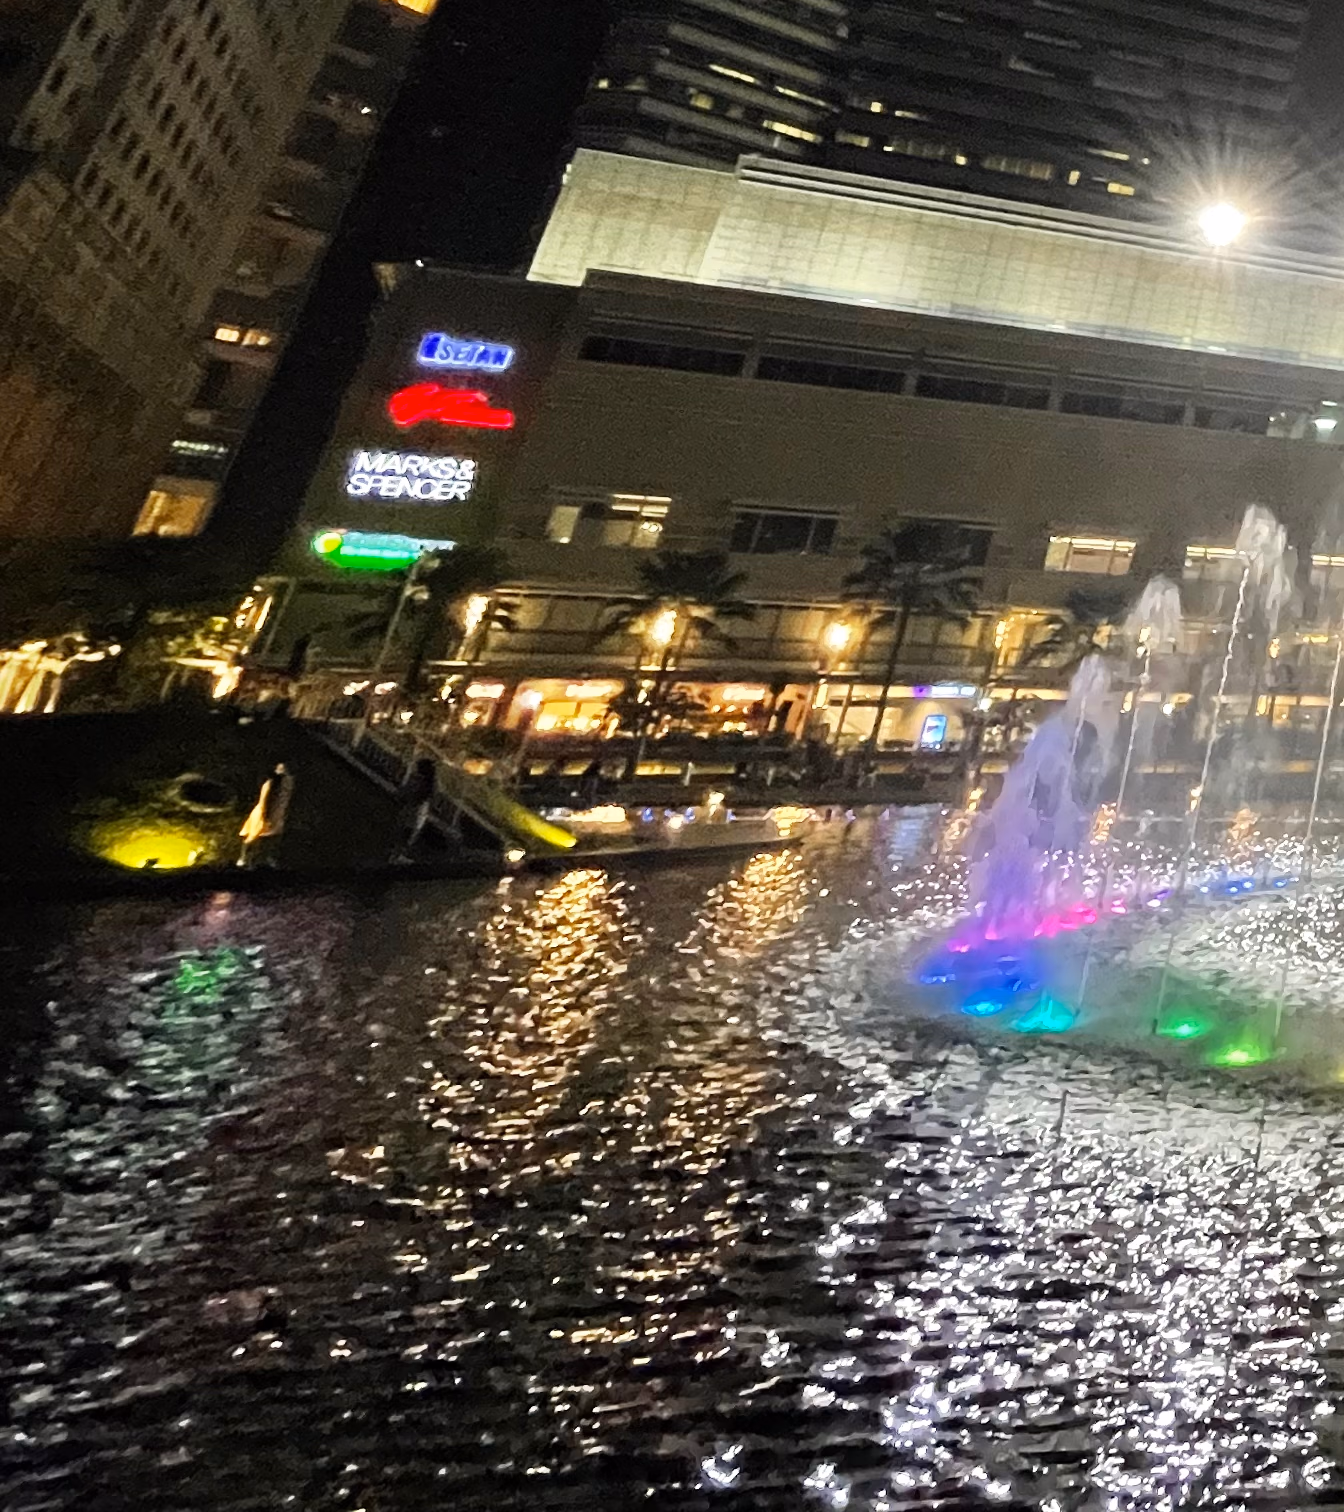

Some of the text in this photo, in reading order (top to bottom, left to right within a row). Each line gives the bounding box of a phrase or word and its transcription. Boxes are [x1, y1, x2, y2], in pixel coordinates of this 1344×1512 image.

[355, 451, 477, 481] MARKS &
[347, 474, 472, 500] SPENCER
